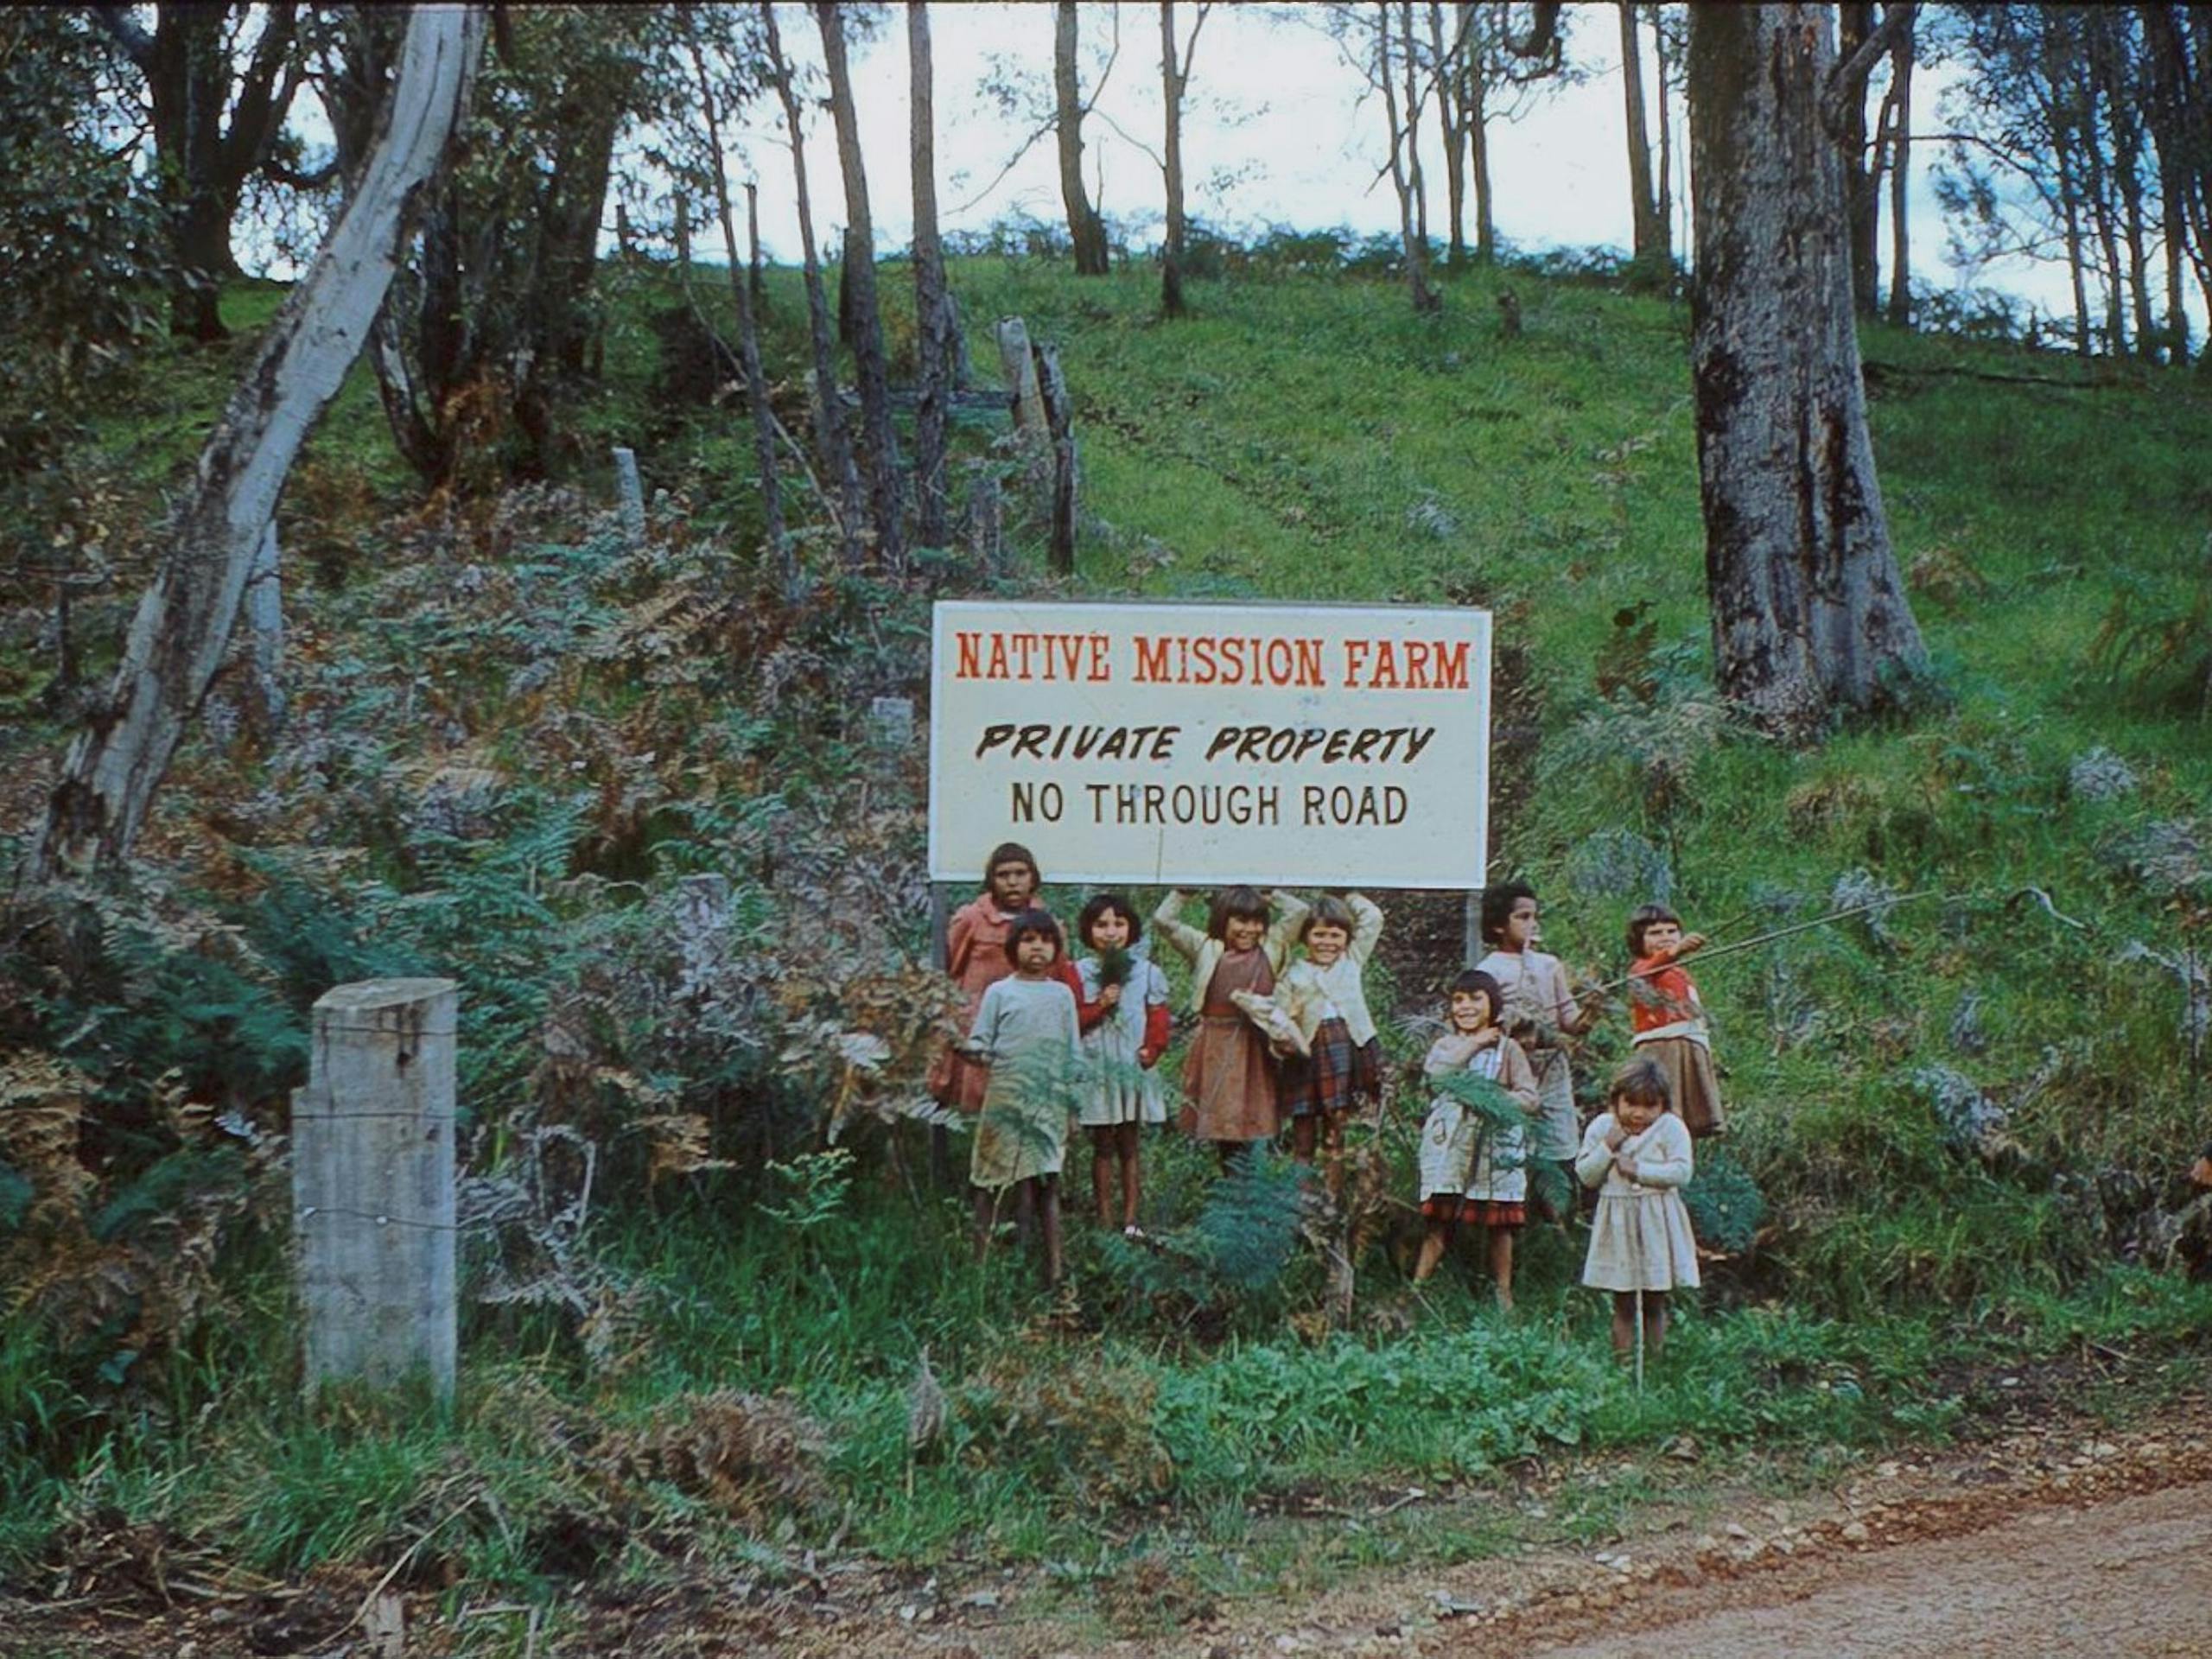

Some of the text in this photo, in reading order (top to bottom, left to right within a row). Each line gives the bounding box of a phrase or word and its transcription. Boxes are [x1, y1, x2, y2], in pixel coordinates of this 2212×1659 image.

[955, 632, 1471, 690] NATIVE MISSION FARM
[975, 723, 1436, 765] PRIVATE PROPERTY
[1011, 782, 1408, 826] NO THROUGH ROAD
